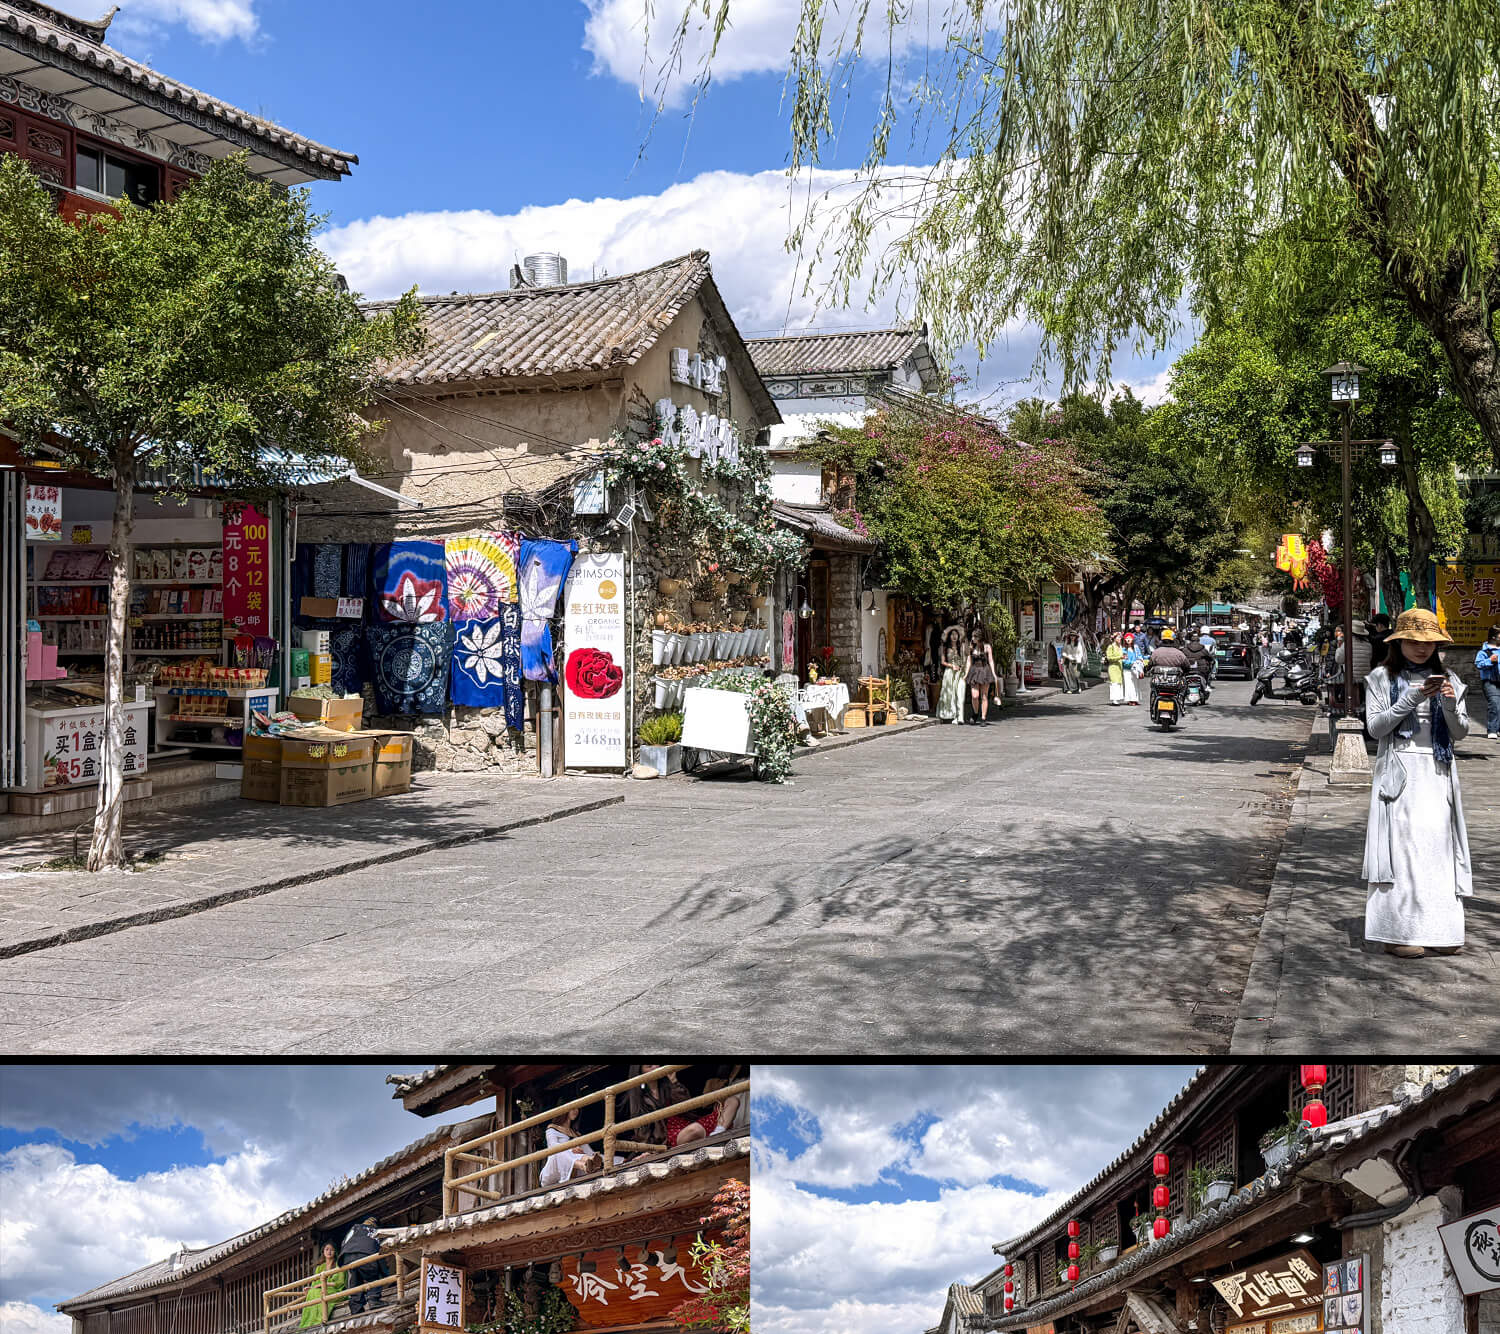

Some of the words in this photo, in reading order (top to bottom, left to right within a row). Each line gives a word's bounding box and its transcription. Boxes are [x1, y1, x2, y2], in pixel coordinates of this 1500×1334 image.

[243, 524, 266, 610] 100元12袋
[567, 568, 623, 579] CRIMSON
[1444, 577, 1497, 597] 大理
[571, 603, 620, 615] 墨红玫瑰
[232, 616, 260, 626] 包邮
[574, 734, 622, 745] 2468m
[427, 1265, 461, 1288] 冷空气
[568, 1250, 729, 1305] 冷空气
